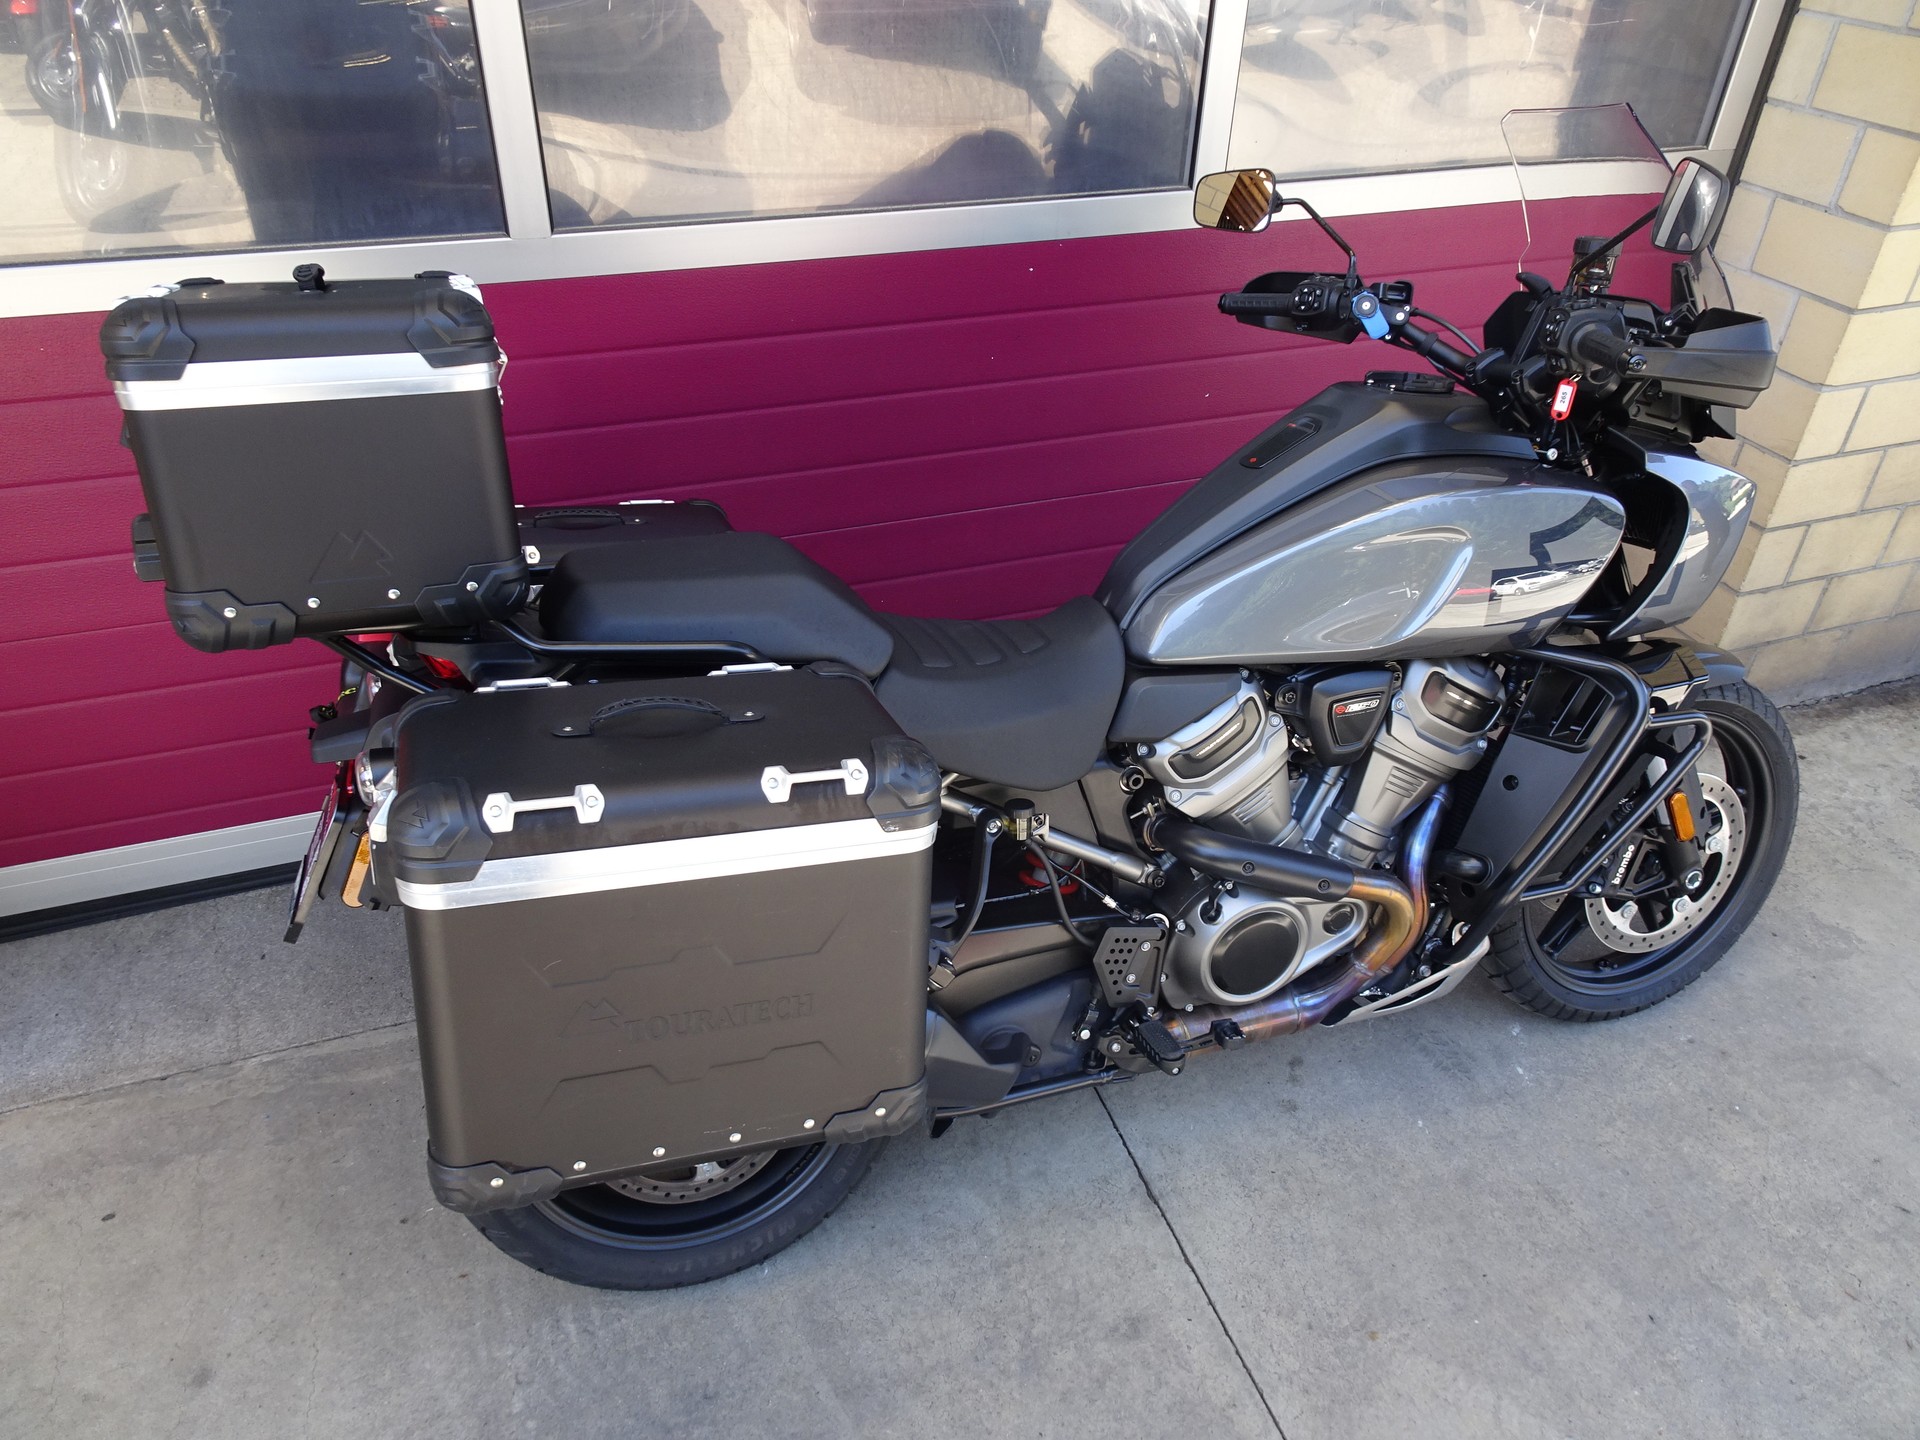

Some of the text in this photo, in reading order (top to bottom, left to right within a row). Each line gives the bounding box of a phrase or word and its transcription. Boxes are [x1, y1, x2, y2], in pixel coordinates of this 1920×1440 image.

[1560, 391, 1568, 404] 265
[1611, 844, 1635, 885] brembo
[624, 993, 813, 1041] TOURATECH
[664, 1217, 796, 1272] MICHELIN
